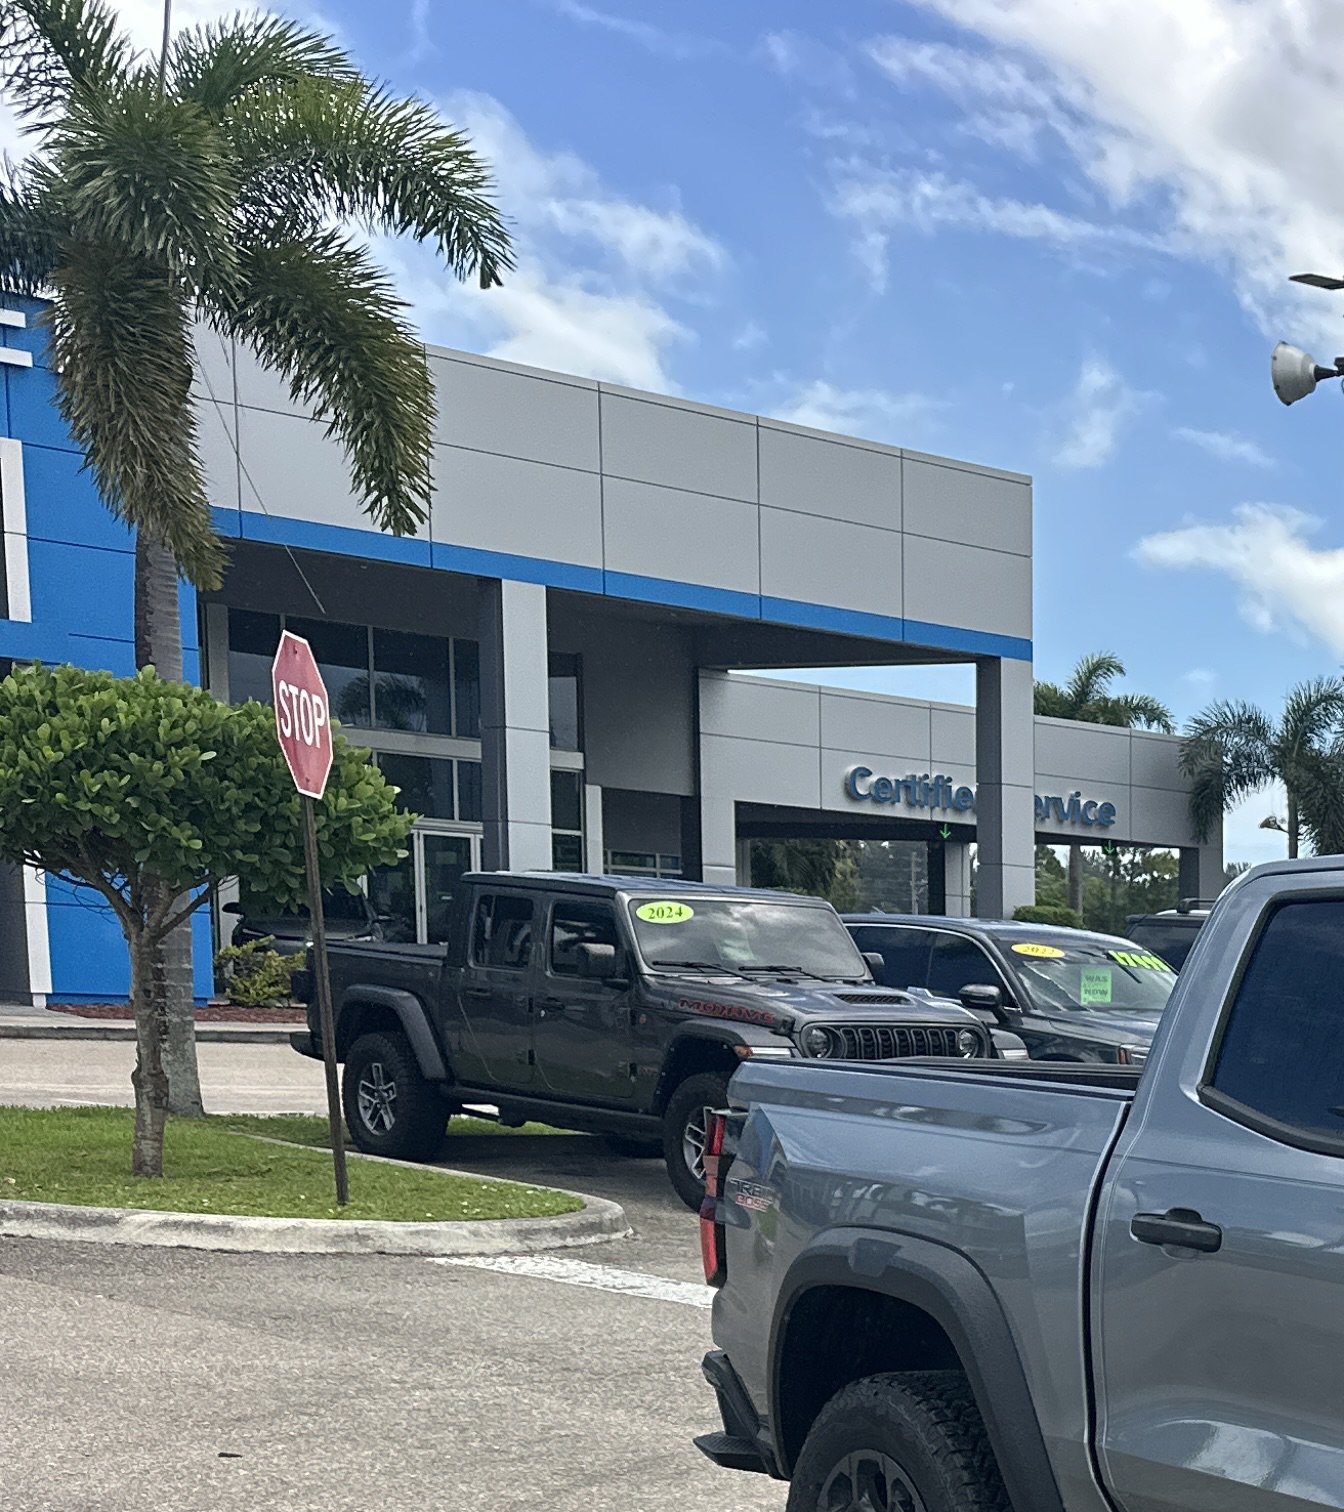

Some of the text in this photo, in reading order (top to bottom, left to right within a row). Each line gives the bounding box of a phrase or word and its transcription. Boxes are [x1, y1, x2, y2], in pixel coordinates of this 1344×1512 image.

[278, 679, 326, 749] STOP
[847, 766, 977, 812] Certifie
[648, 906, 683, 919] 2024
